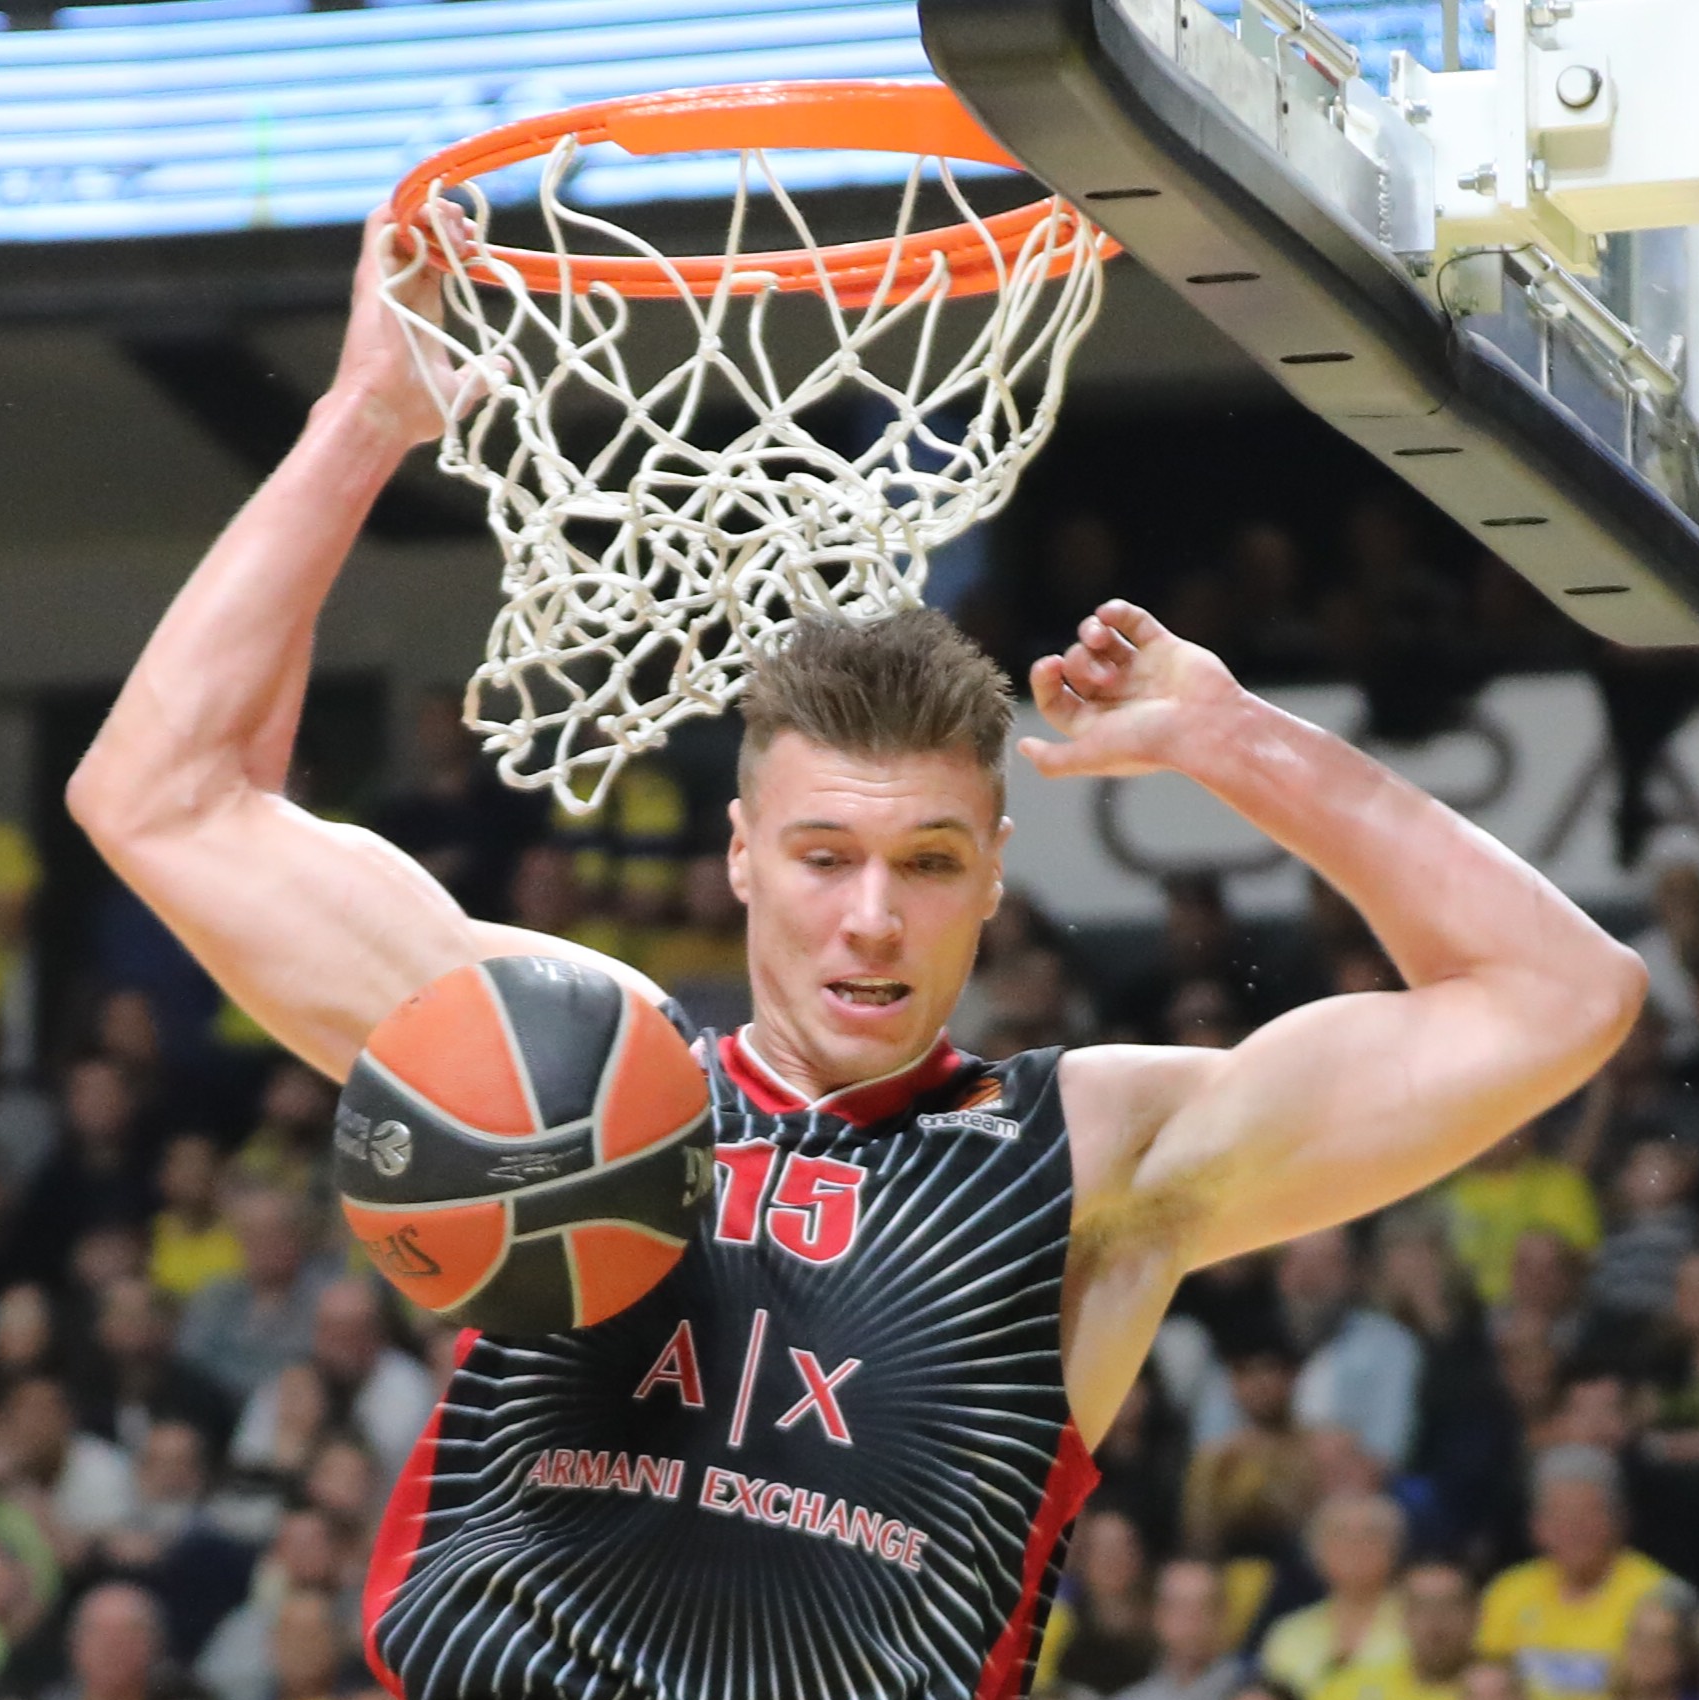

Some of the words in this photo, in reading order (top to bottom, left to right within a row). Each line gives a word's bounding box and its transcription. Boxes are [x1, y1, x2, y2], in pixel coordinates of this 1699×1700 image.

[714, 1136, 869, 1265] 15
[528, 1448, 685, 1500] ARMANI
[699, 1465, 929, 1573] EXCHANGE
